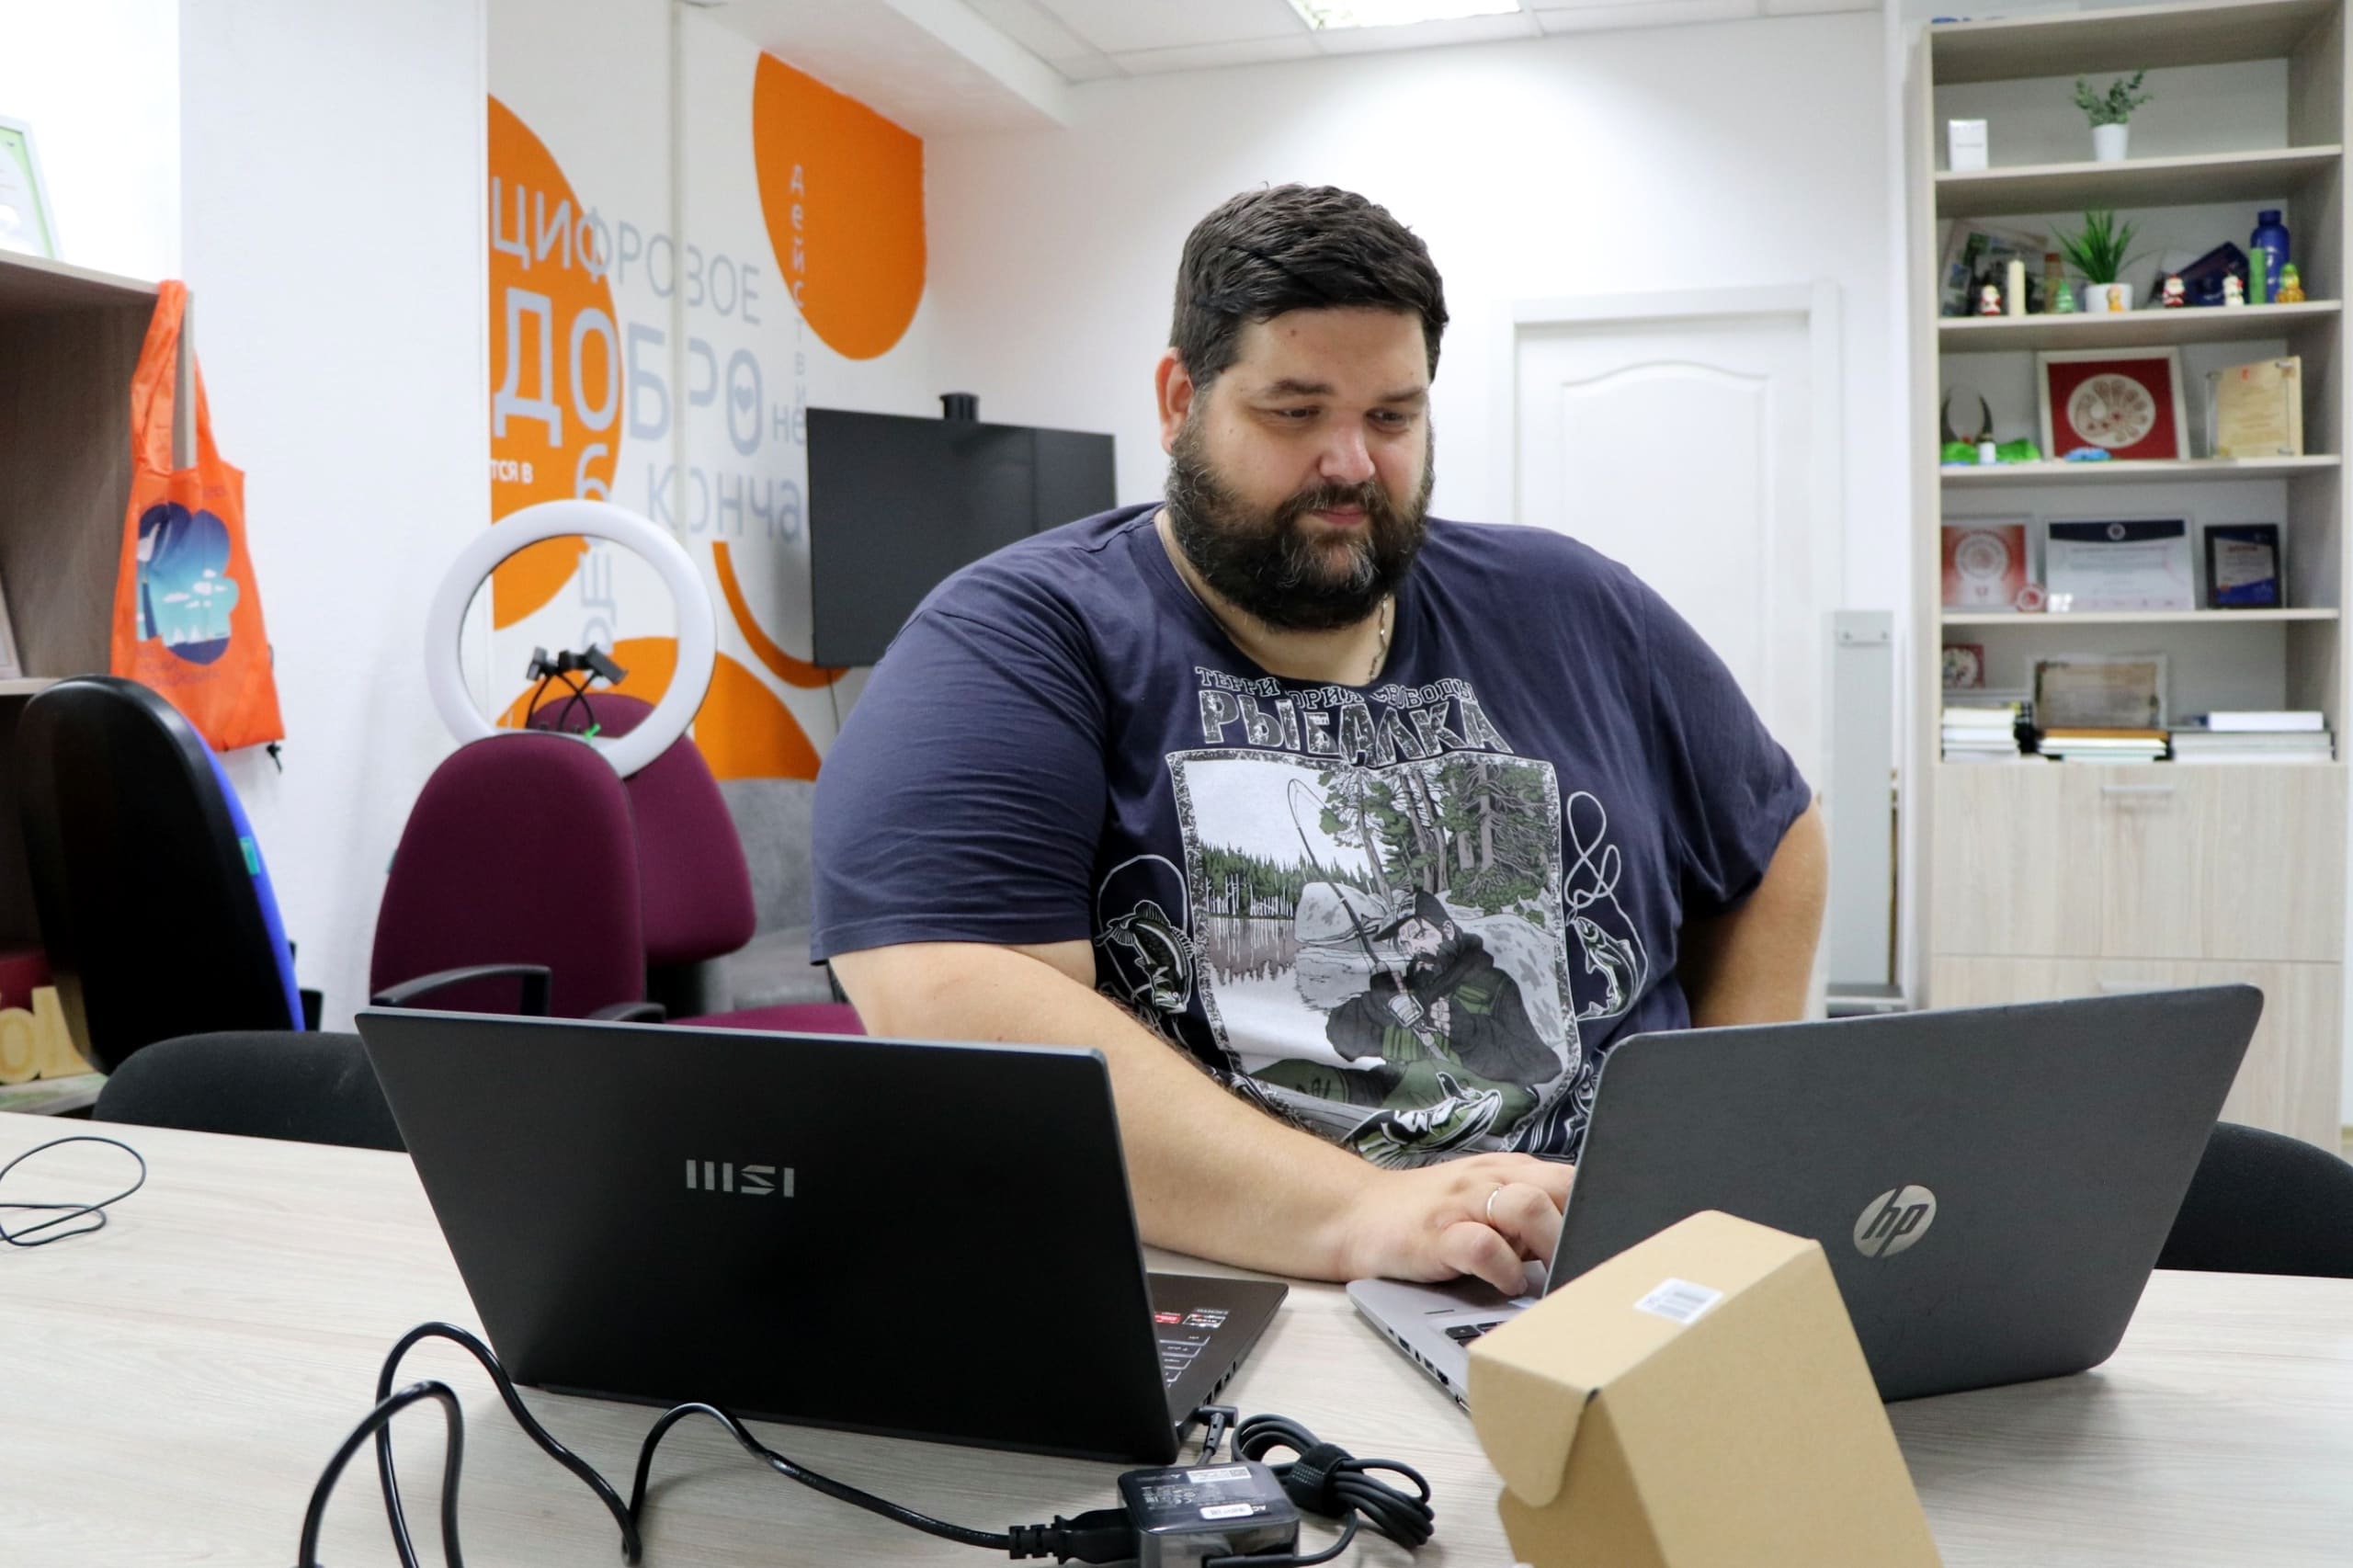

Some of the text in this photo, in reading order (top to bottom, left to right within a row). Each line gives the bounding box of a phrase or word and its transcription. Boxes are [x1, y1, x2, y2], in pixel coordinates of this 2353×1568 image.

[493, 176, 762, 326] ЦИФРОВОЕ
[494, 286, 763, 456] ДОБРО
[1199, 690, 1514, 768] РЫБАЛКА
[1855, 1185, 1935, 1257] hp
